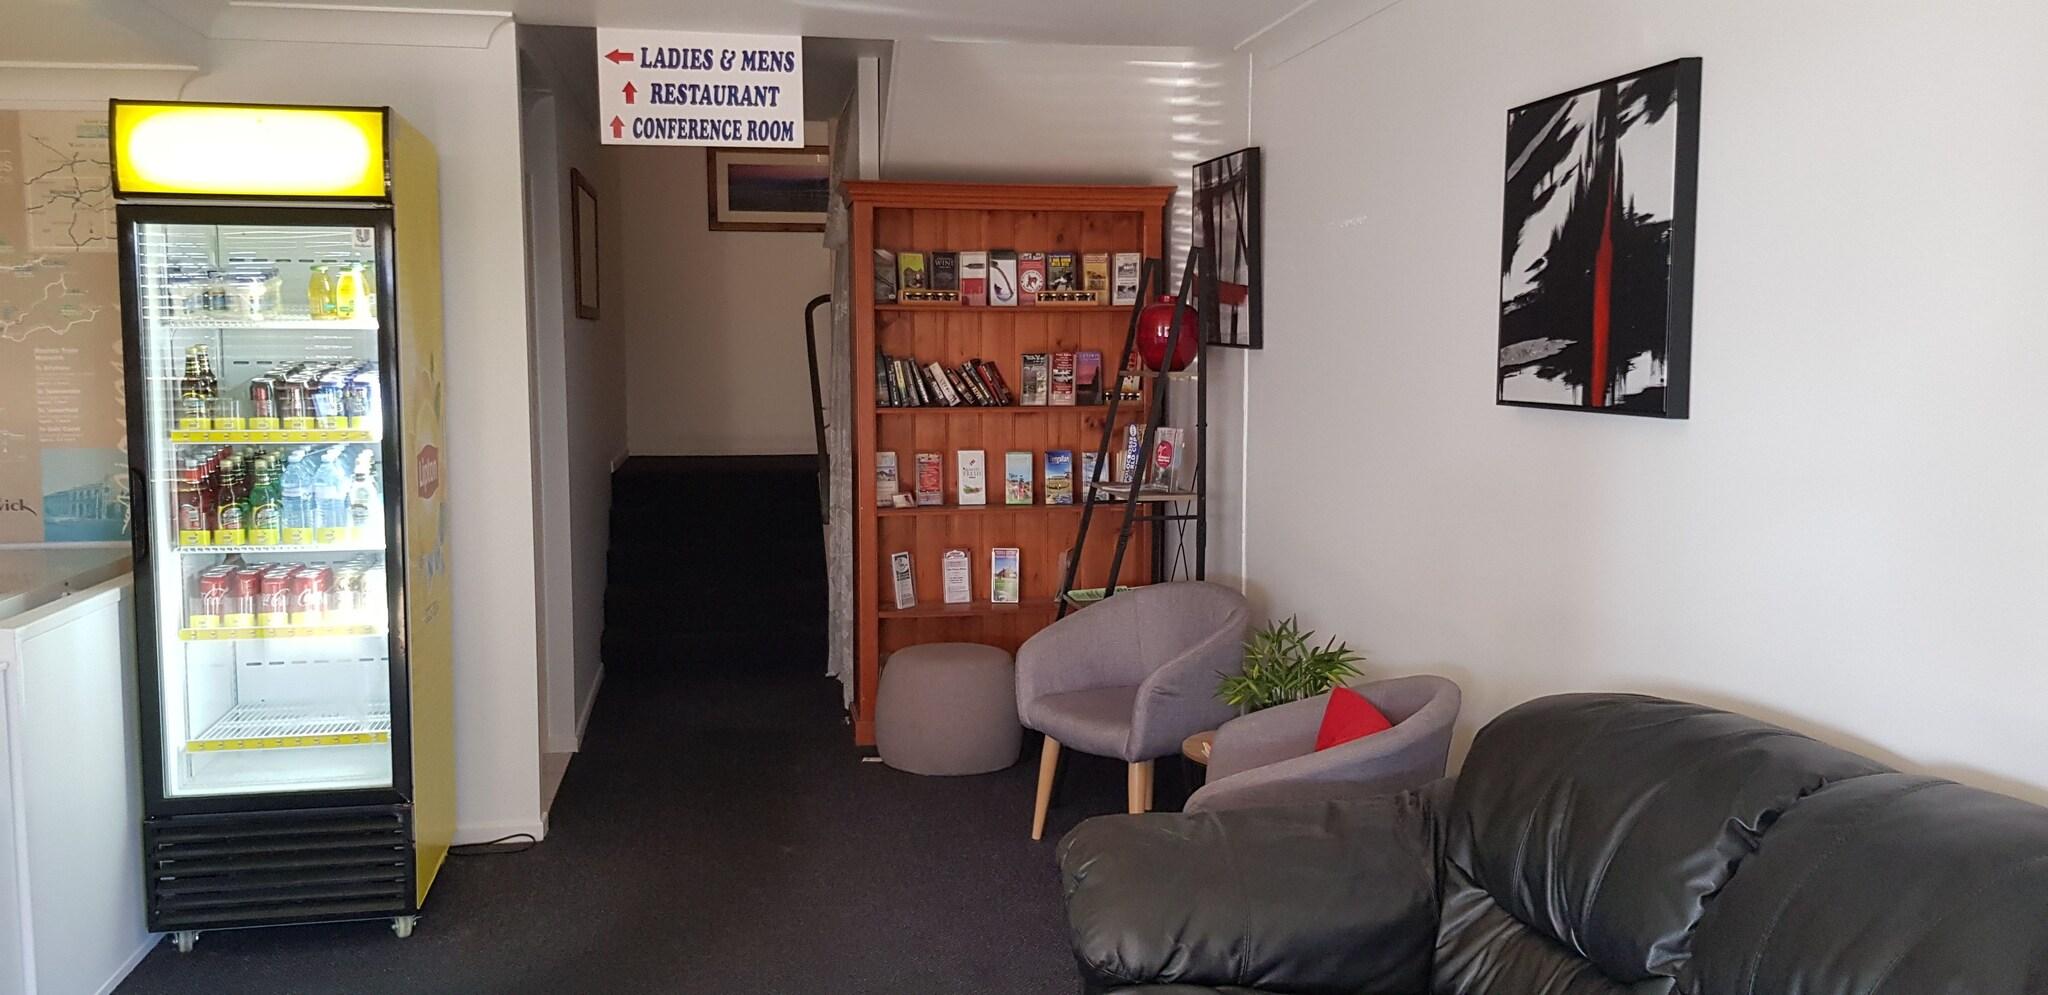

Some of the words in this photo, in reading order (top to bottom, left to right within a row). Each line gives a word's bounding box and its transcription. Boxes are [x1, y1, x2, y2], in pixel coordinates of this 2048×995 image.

[640, 47, 714, 71] LADIES
[720, 49, 736, 71] &
[741, 50, 795, 73] MENS
[650, 82, 780, 107] RESTAURANT
[632, 117, 742, 141] CONFERENCE
[747, 120, 795, 142] ROOM
